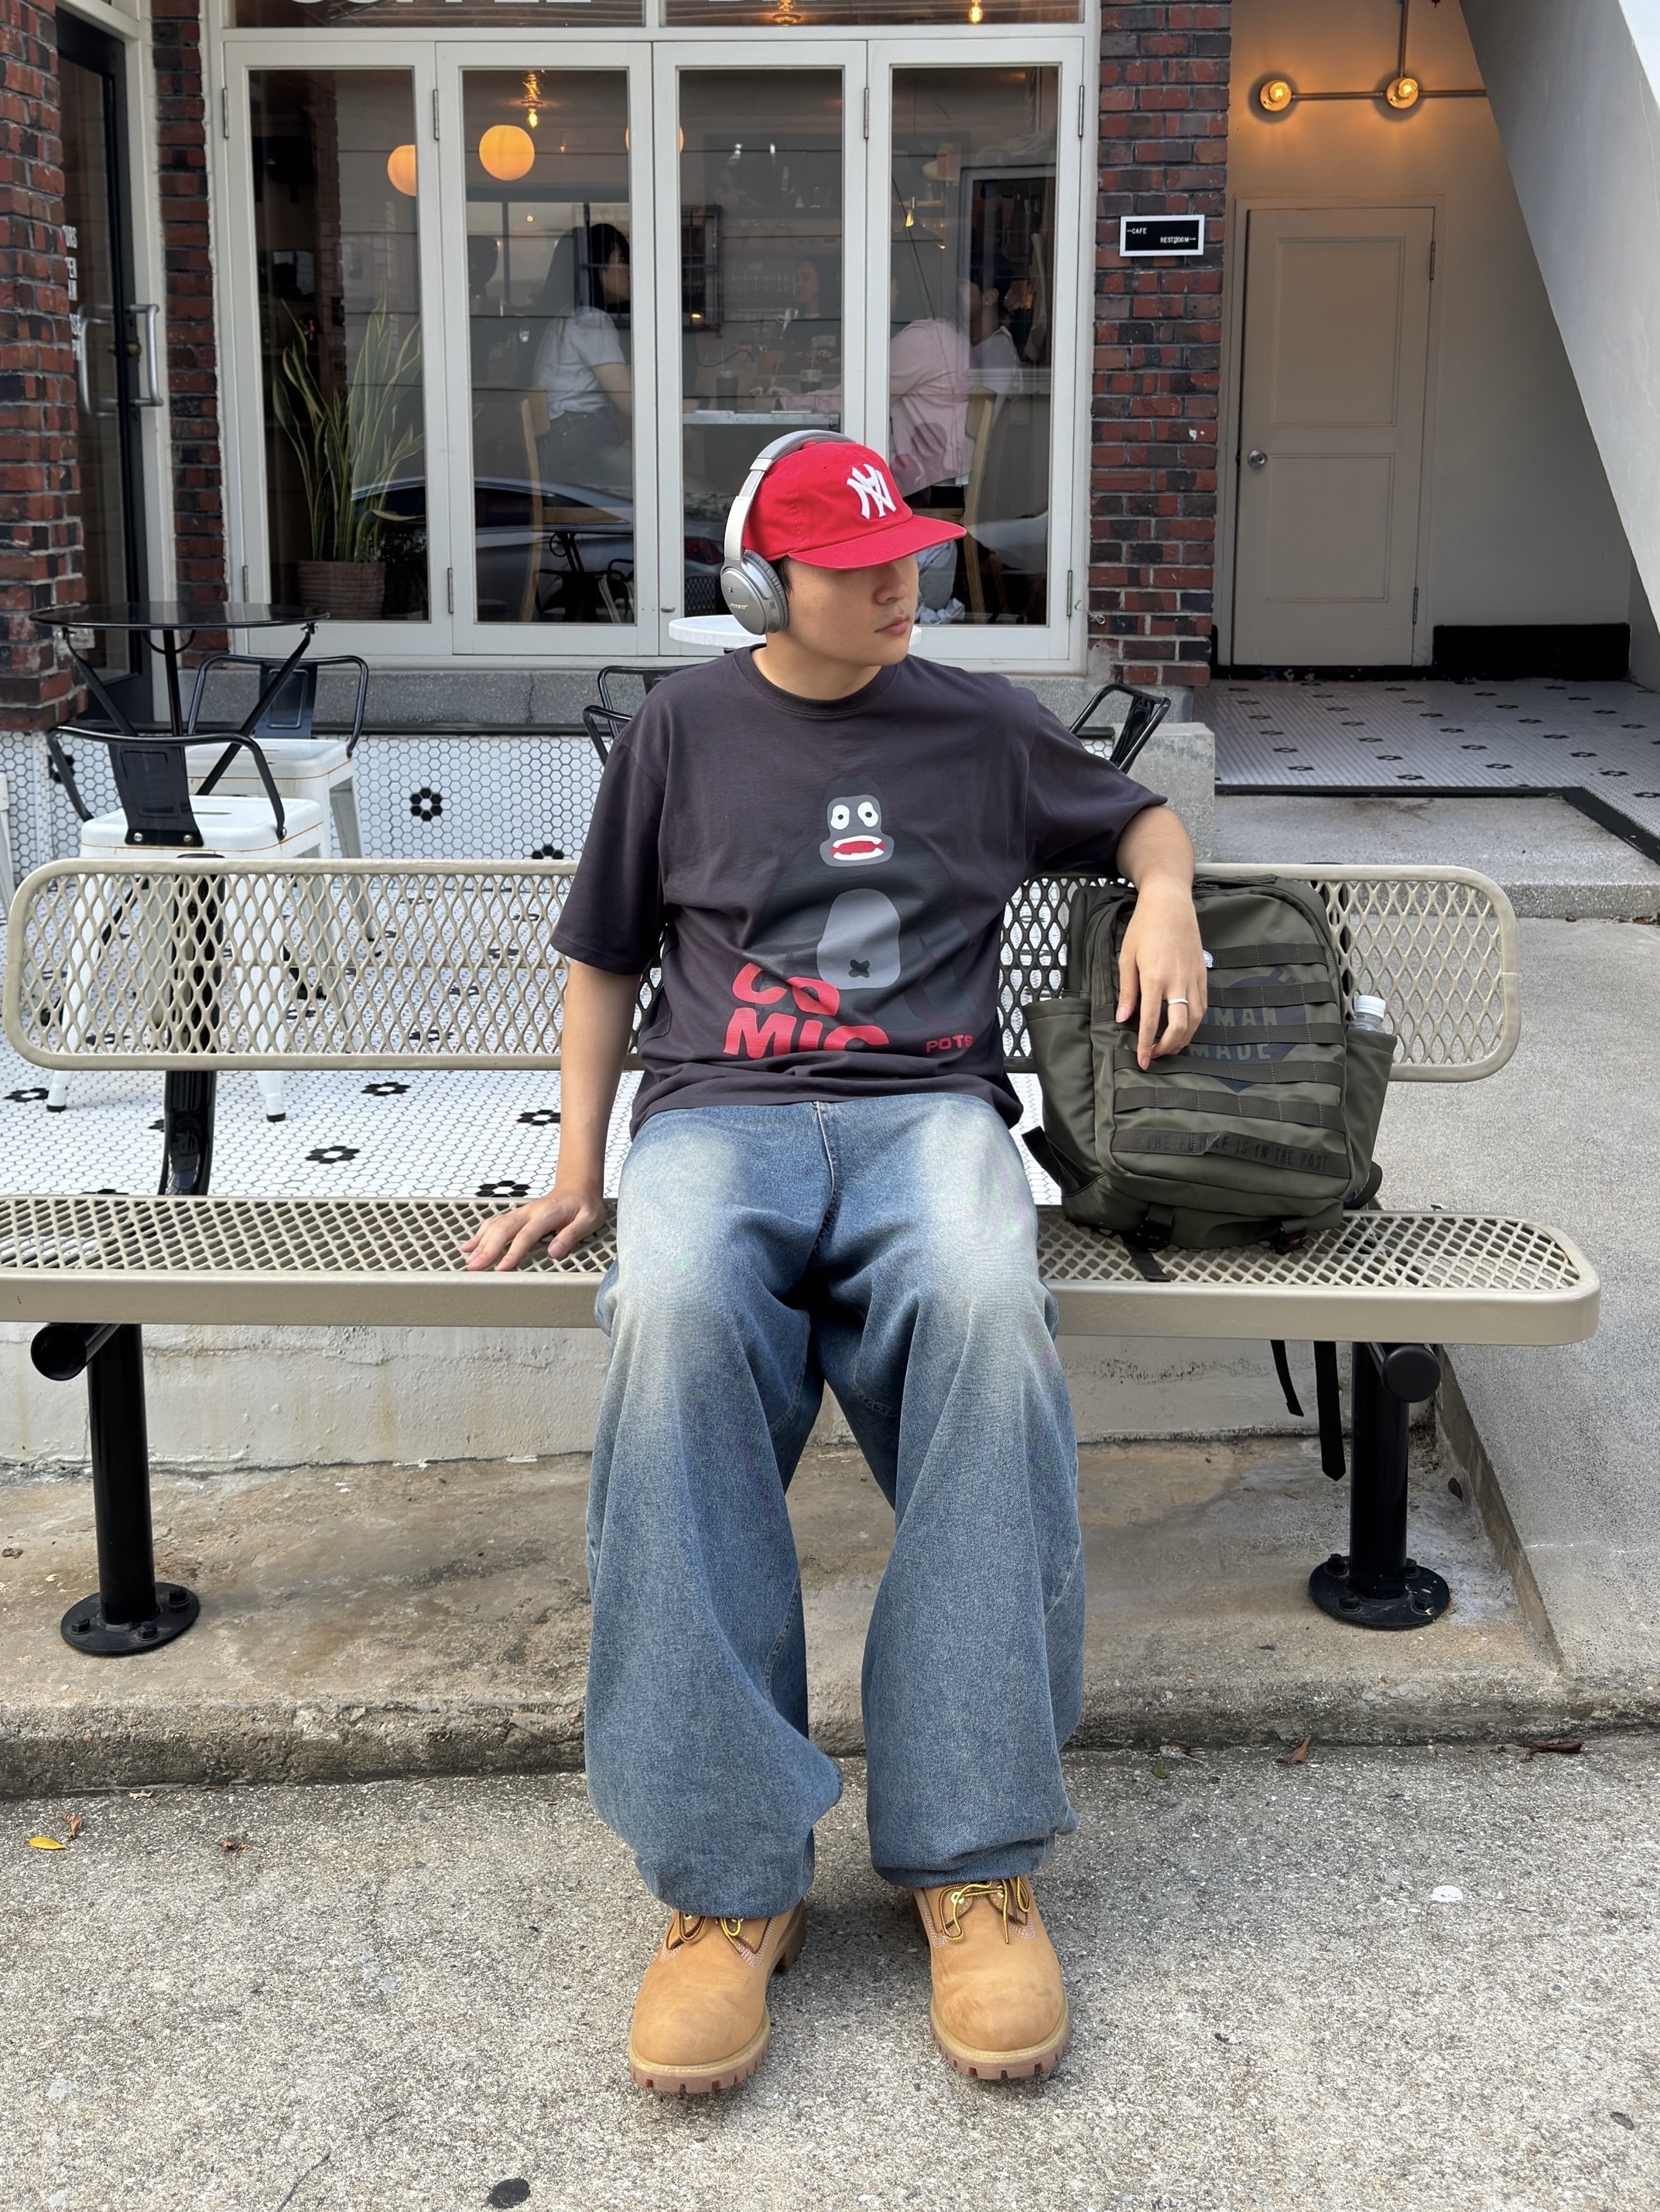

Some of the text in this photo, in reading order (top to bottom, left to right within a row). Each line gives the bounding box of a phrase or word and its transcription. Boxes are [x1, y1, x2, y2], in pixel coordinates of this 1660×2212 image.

[1203, 1007, 1278, 1027] MAN
[1254, 1144, 1269, 1159] IN
[1275, 1147, 1294, 1164] THE
[1300, 1152, 1328, 1171] PAST
